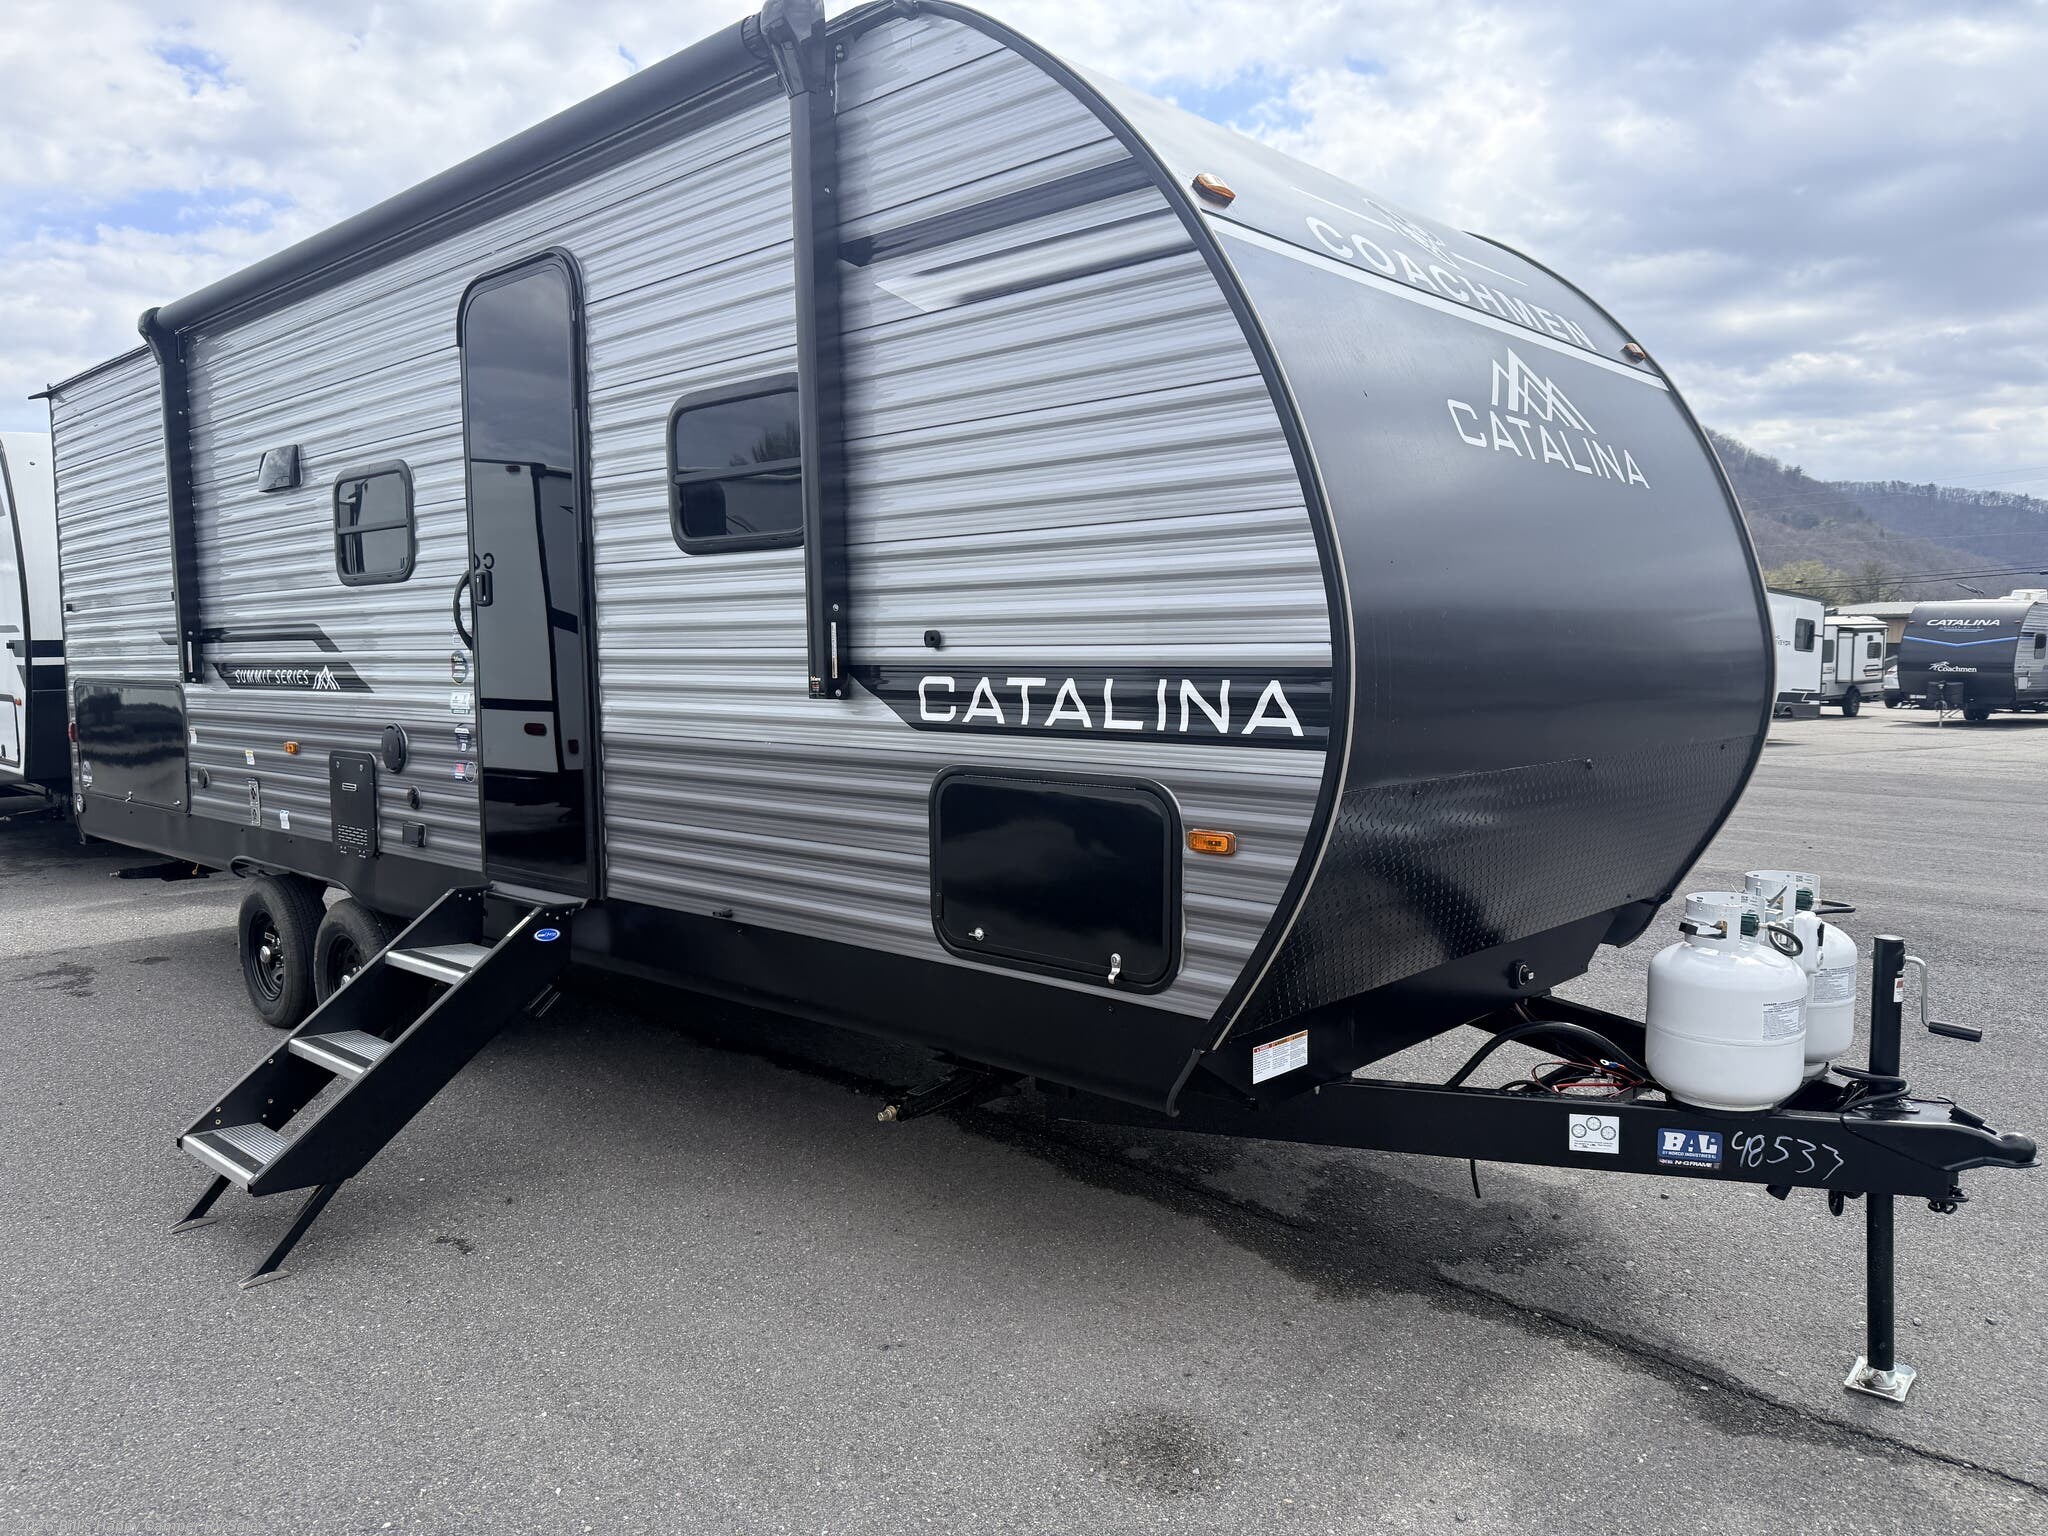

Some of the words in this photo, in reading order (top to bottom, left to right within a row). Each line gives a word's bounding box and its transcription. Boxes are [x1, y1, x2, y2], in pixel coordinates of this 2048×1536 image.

[1306, 216, 1597, 351] COACHMEN
[1447, 398, 1651, 489] CATALINA
[1926, 619, 2000, 627] CATALINA
[234, 669, 272, 684] SUMMIT
[274, 669, 309, 685] SERIES
[917, 675, 1305, 737] CATALINA
